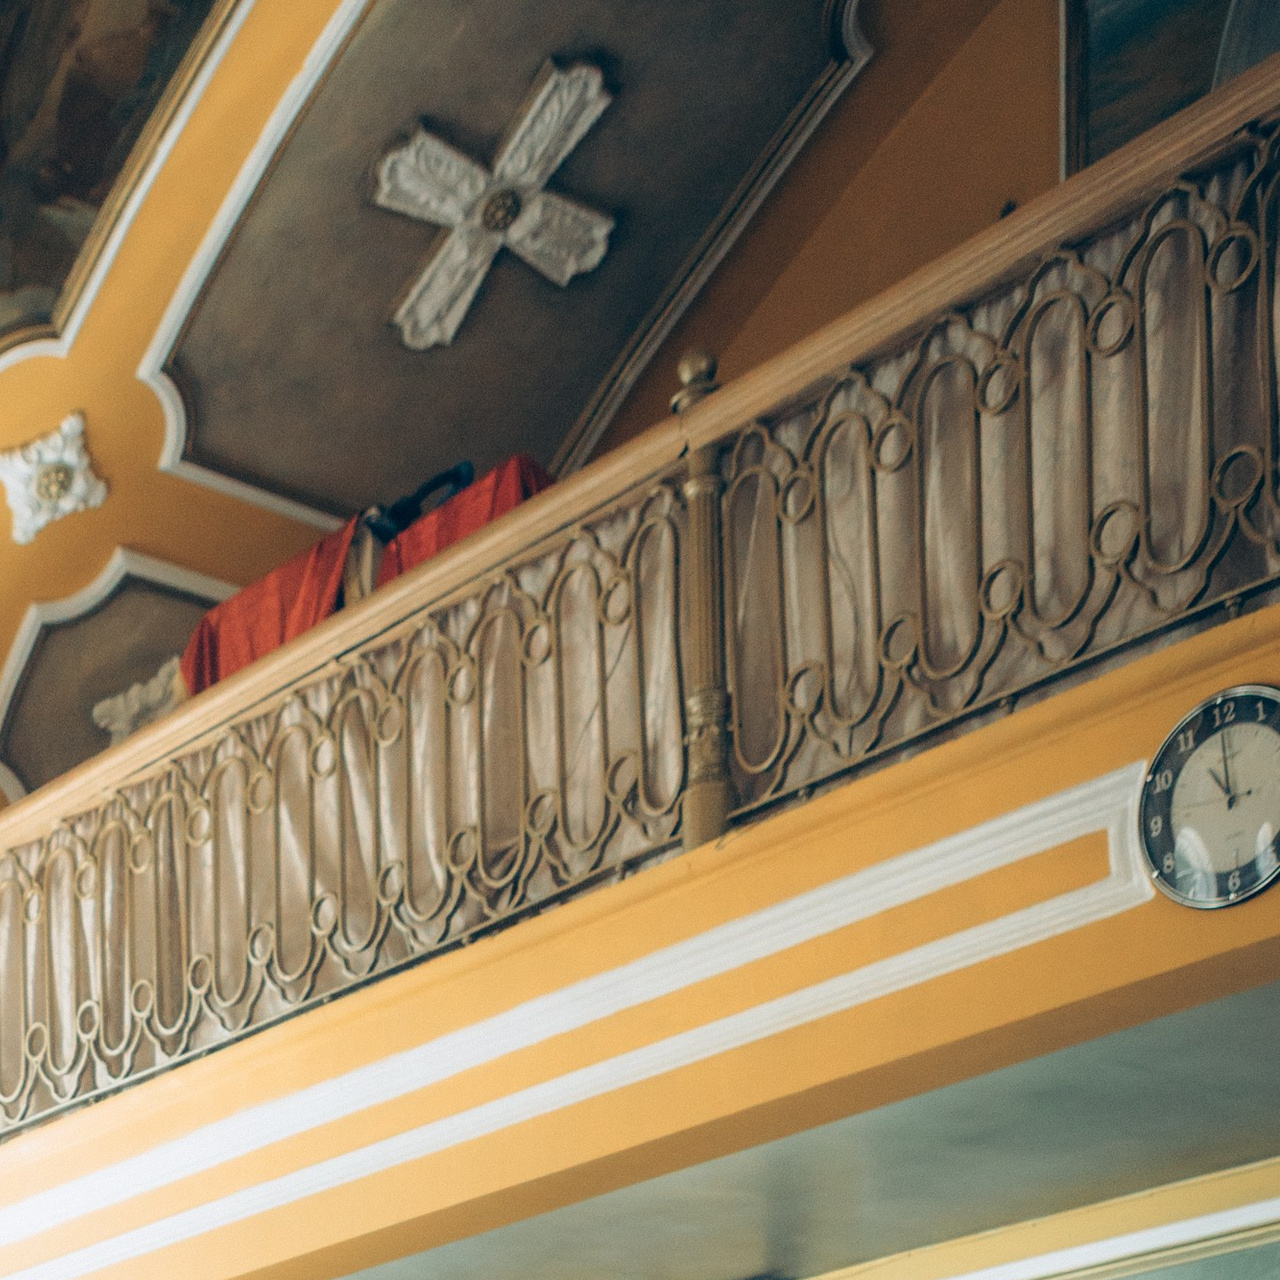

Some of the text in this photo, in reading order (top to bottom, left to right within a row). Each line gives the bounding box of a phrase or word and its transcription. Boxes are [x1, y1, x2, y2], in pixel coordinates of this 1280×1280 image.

[1212, 701, 1236, 728] 12
[1256, 700, 1267, 722] 1
[1177, 729, 1196, 754] 11
[1153, 768, 1173, 795] 10
[1150, 815, 1163, 838] 9
[1163, 852, 1175, 874] 8
[1228, 870, 1241, 892] 6
